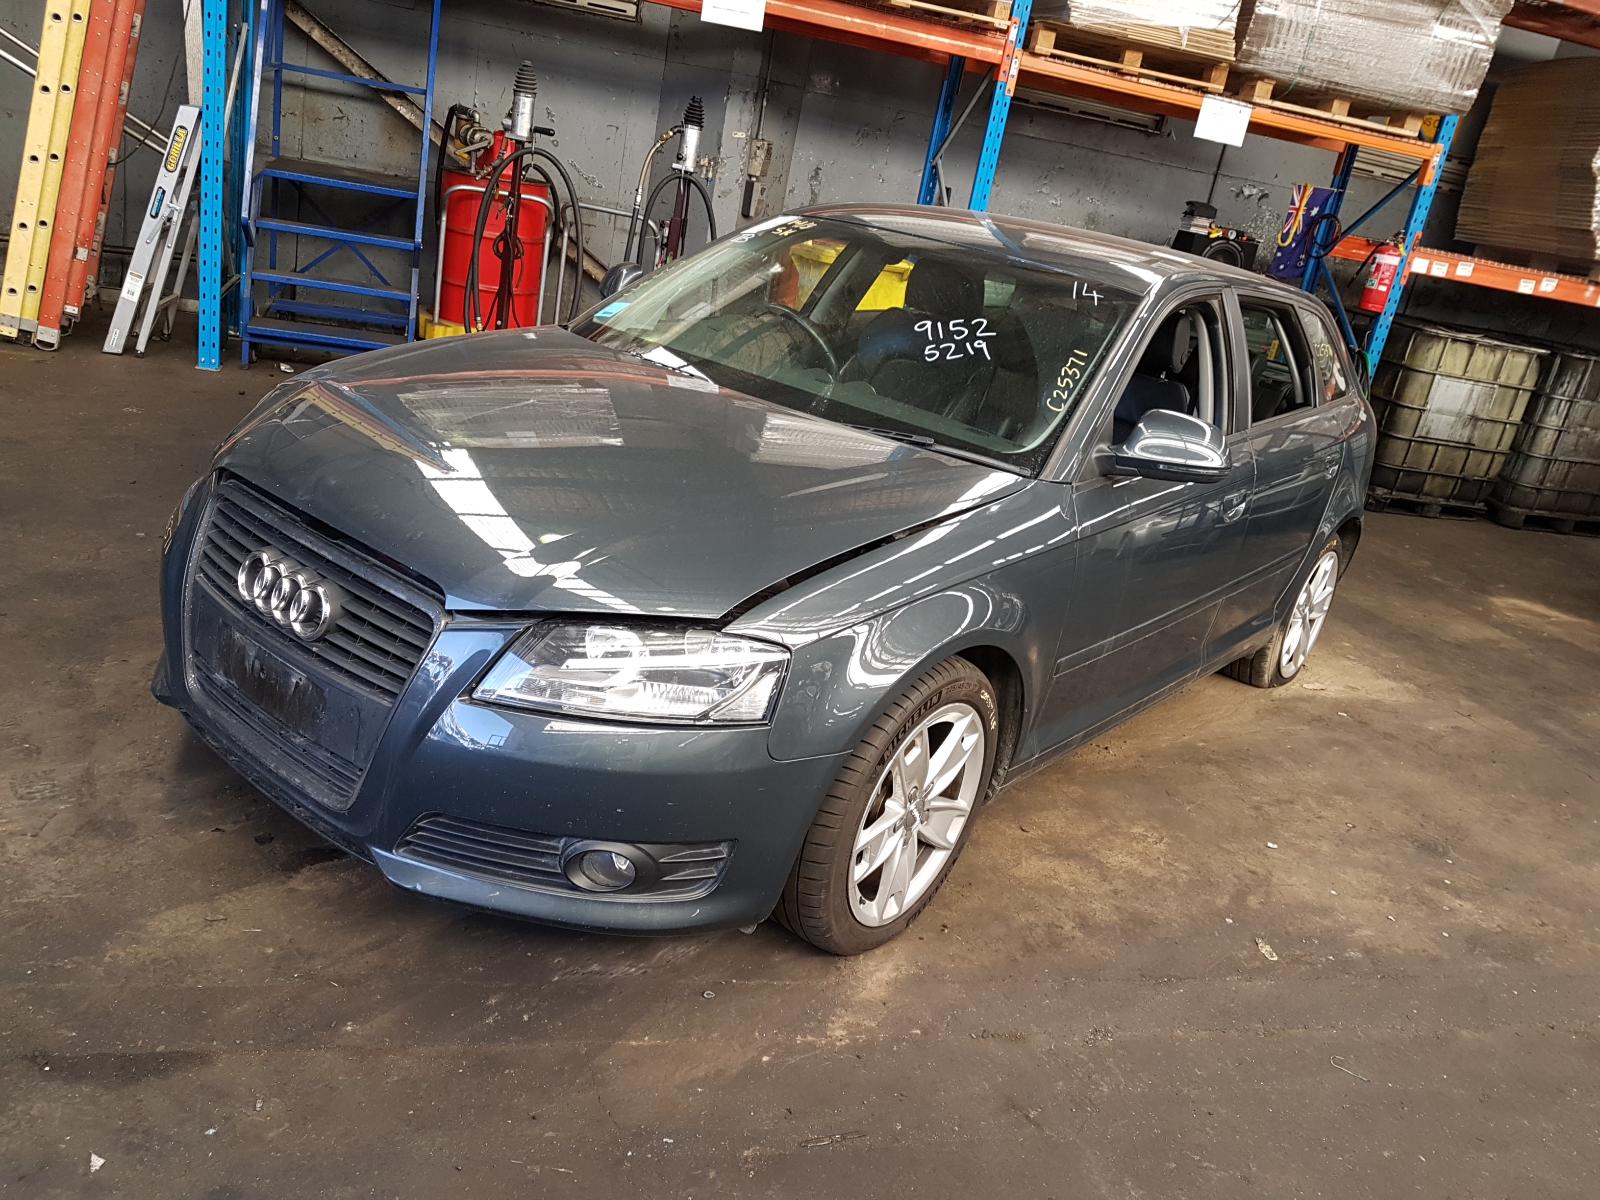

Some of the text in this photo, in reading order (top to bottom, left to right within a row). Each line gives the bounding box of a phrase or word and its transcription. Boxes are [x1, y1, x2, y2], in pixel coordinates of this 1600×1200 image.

[166, 127, 187, 171] GORILLA
[1072, 281, 1105, 306] 14
[914, 318, 997, 341] 9152
[924, 339, 991, 362] 5219
[1046, 349, 1088, 412] C25371
[883, 689, 943, 764] MICHELIN
